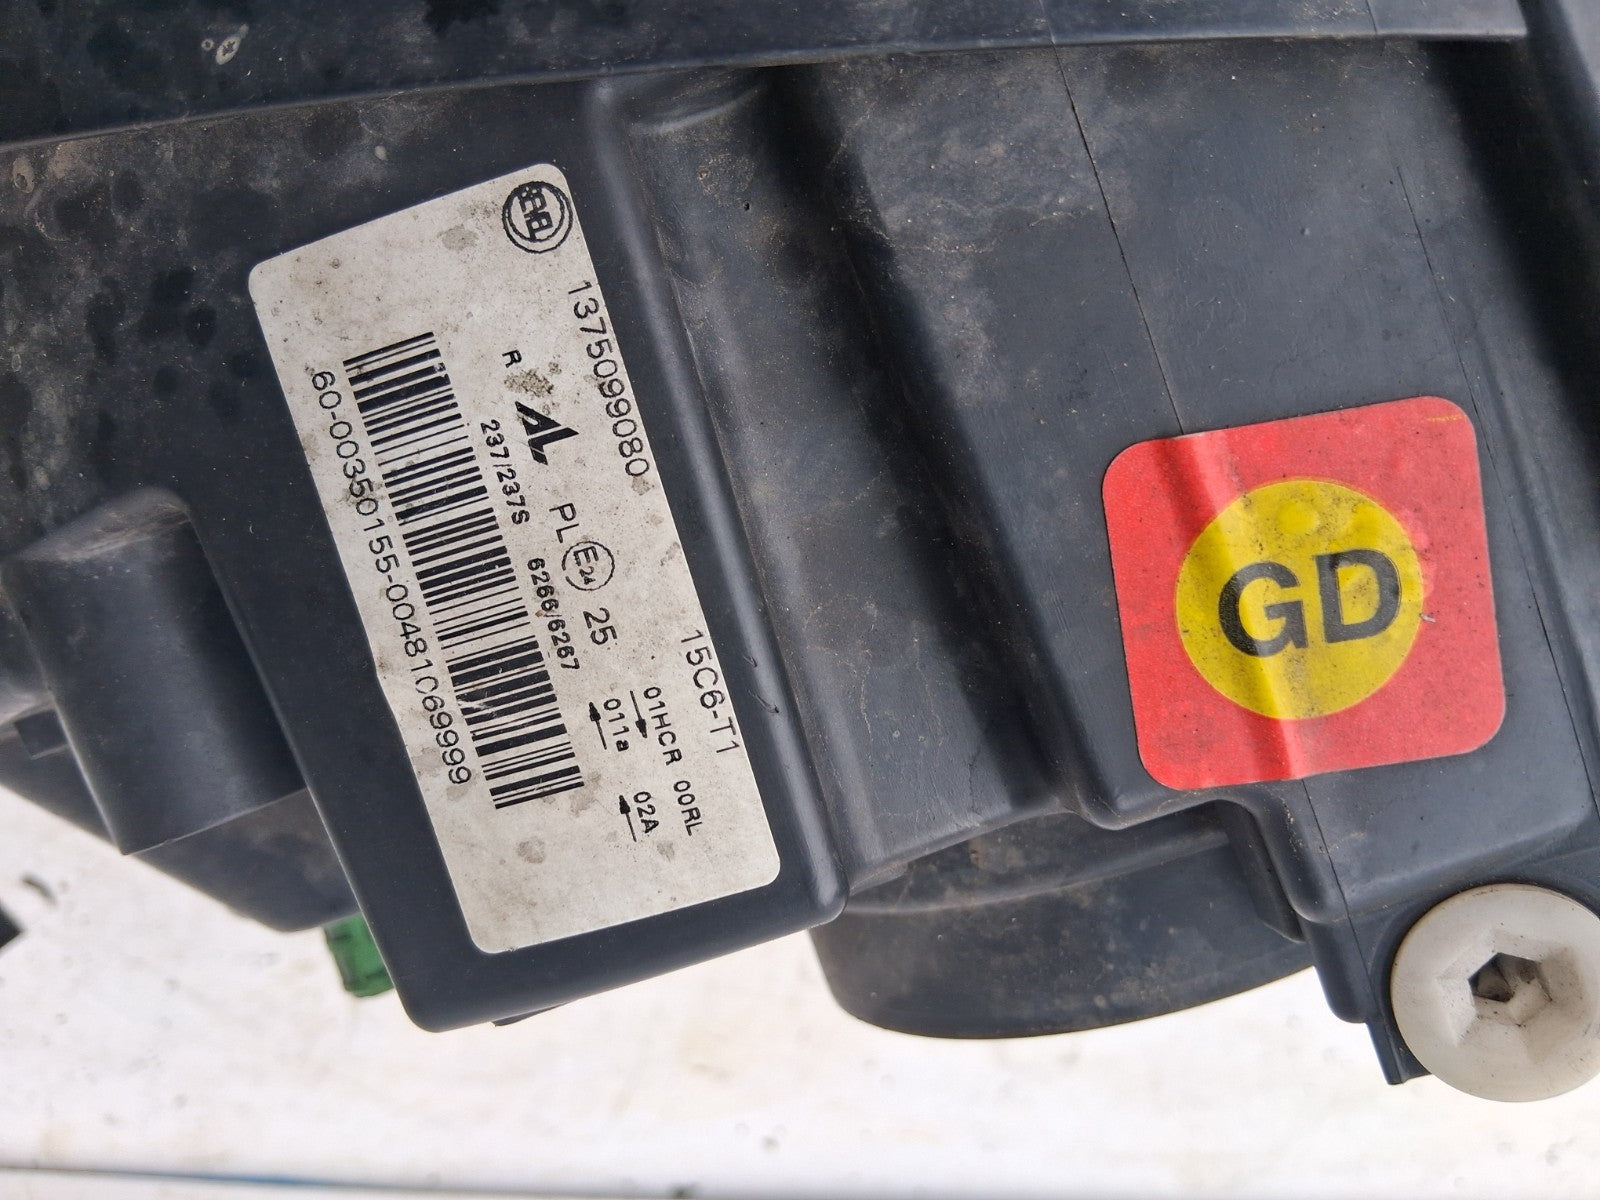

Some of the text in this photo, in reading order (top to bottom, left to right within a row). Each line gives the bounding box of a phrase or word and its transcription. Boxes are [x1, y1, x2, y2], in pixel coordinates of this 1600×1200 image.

[501, 349, 523, 369] R
[311, 370, 472, 785] 60-00350155-00481069999
[480, 419, 579, 670] 237/237S 6266/6267
[548, 502, 580, 544] PL
[582, 607, 618, 646] 25
[567, 281, 740, 754] 1375099080 15C6-T1
[1218, 548, 1401, 657] GD
[633, 791, 660, 834] 02A
[643, 686, 703, 837] 01HCR 00RL
